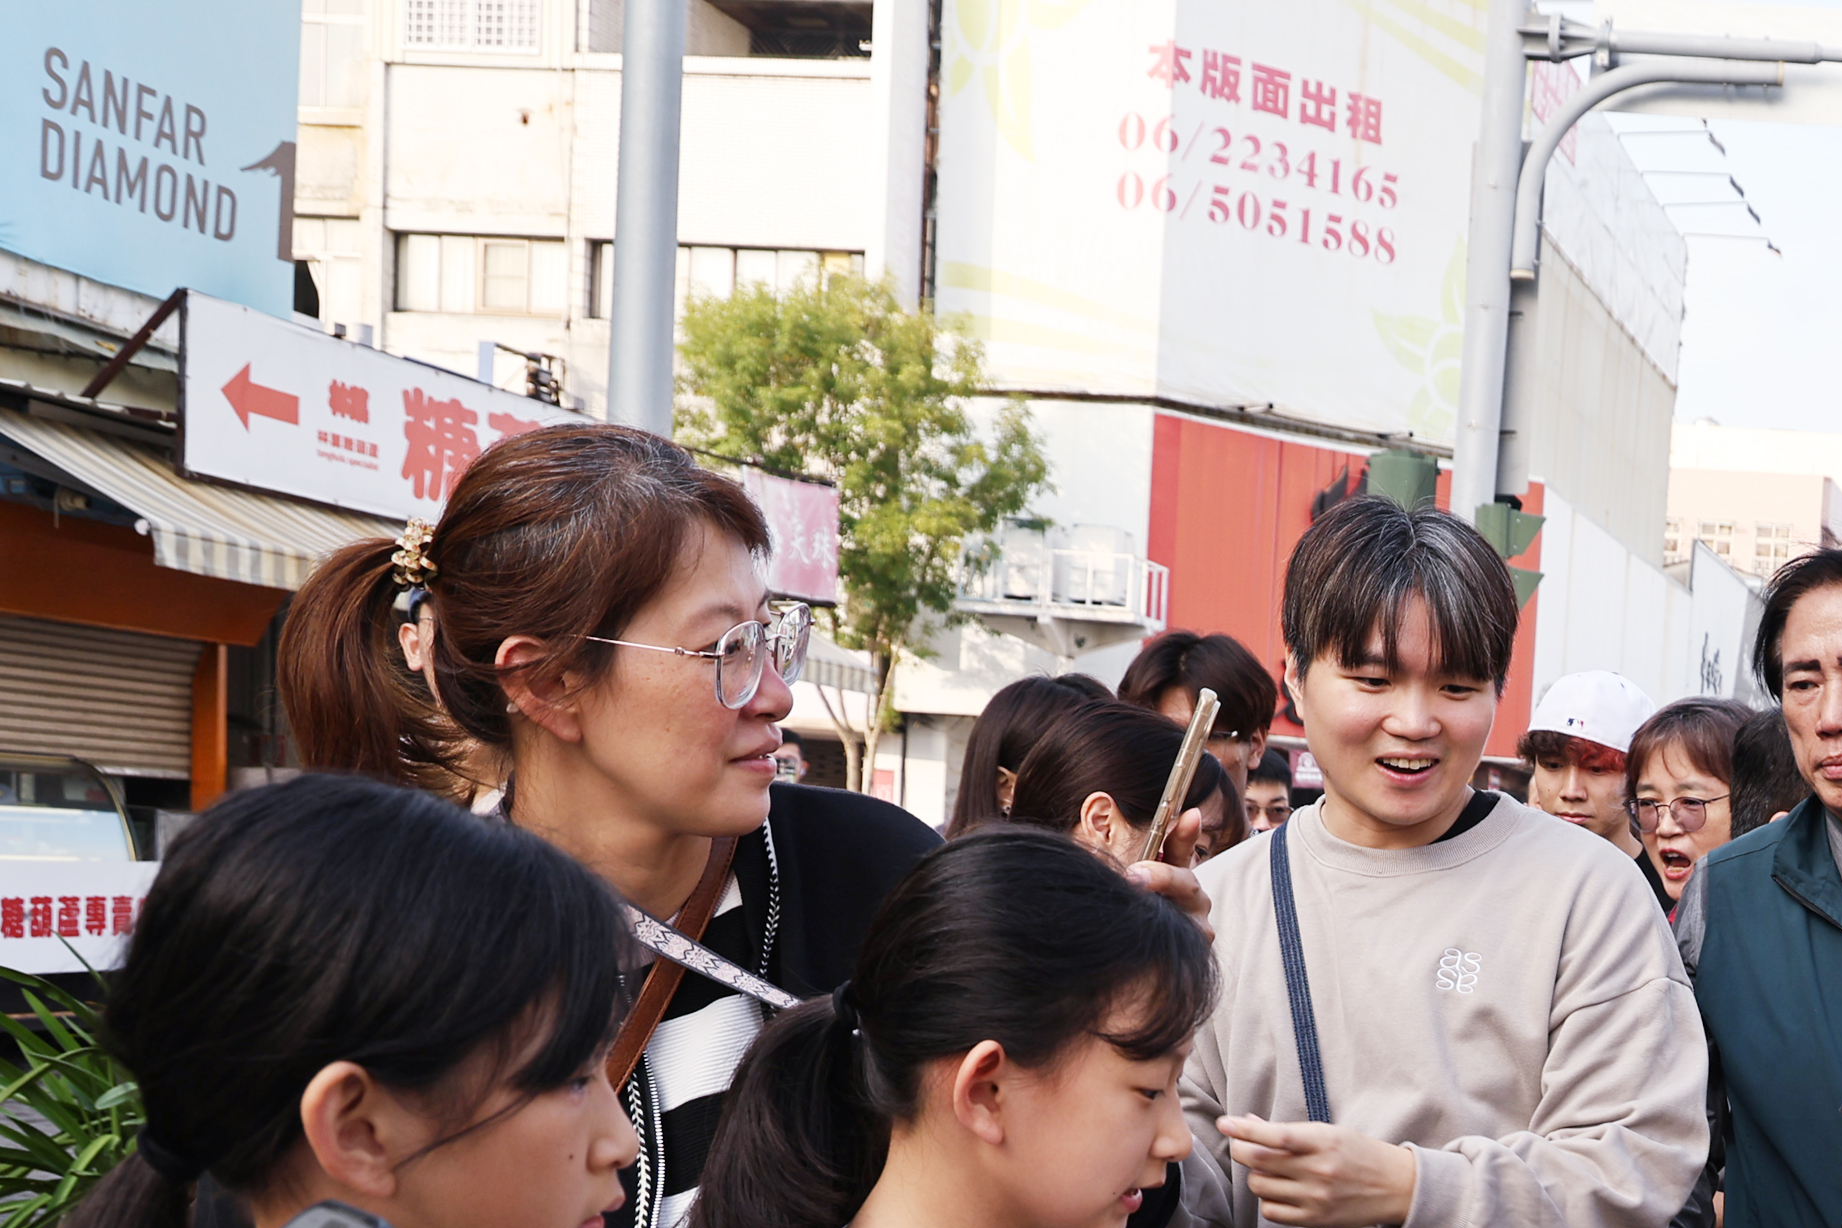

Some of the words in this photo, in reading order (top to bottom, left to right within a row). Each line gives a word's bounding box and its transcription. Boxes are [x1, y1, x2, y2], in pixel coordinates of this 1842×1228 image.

[41, 46, 208, 167] SANFAR
[1146, 39, 1383, 146] 本版面出租
[40, 116, 238, 242] DIAMOND
[1117, 110, 1399, 210] 06/2234165
[1116, 170, 1397, 265] 06/5051588
[402, 386, 543, 502] 糖
[1, 896, 147, 939] 糖葫蘆專賣
